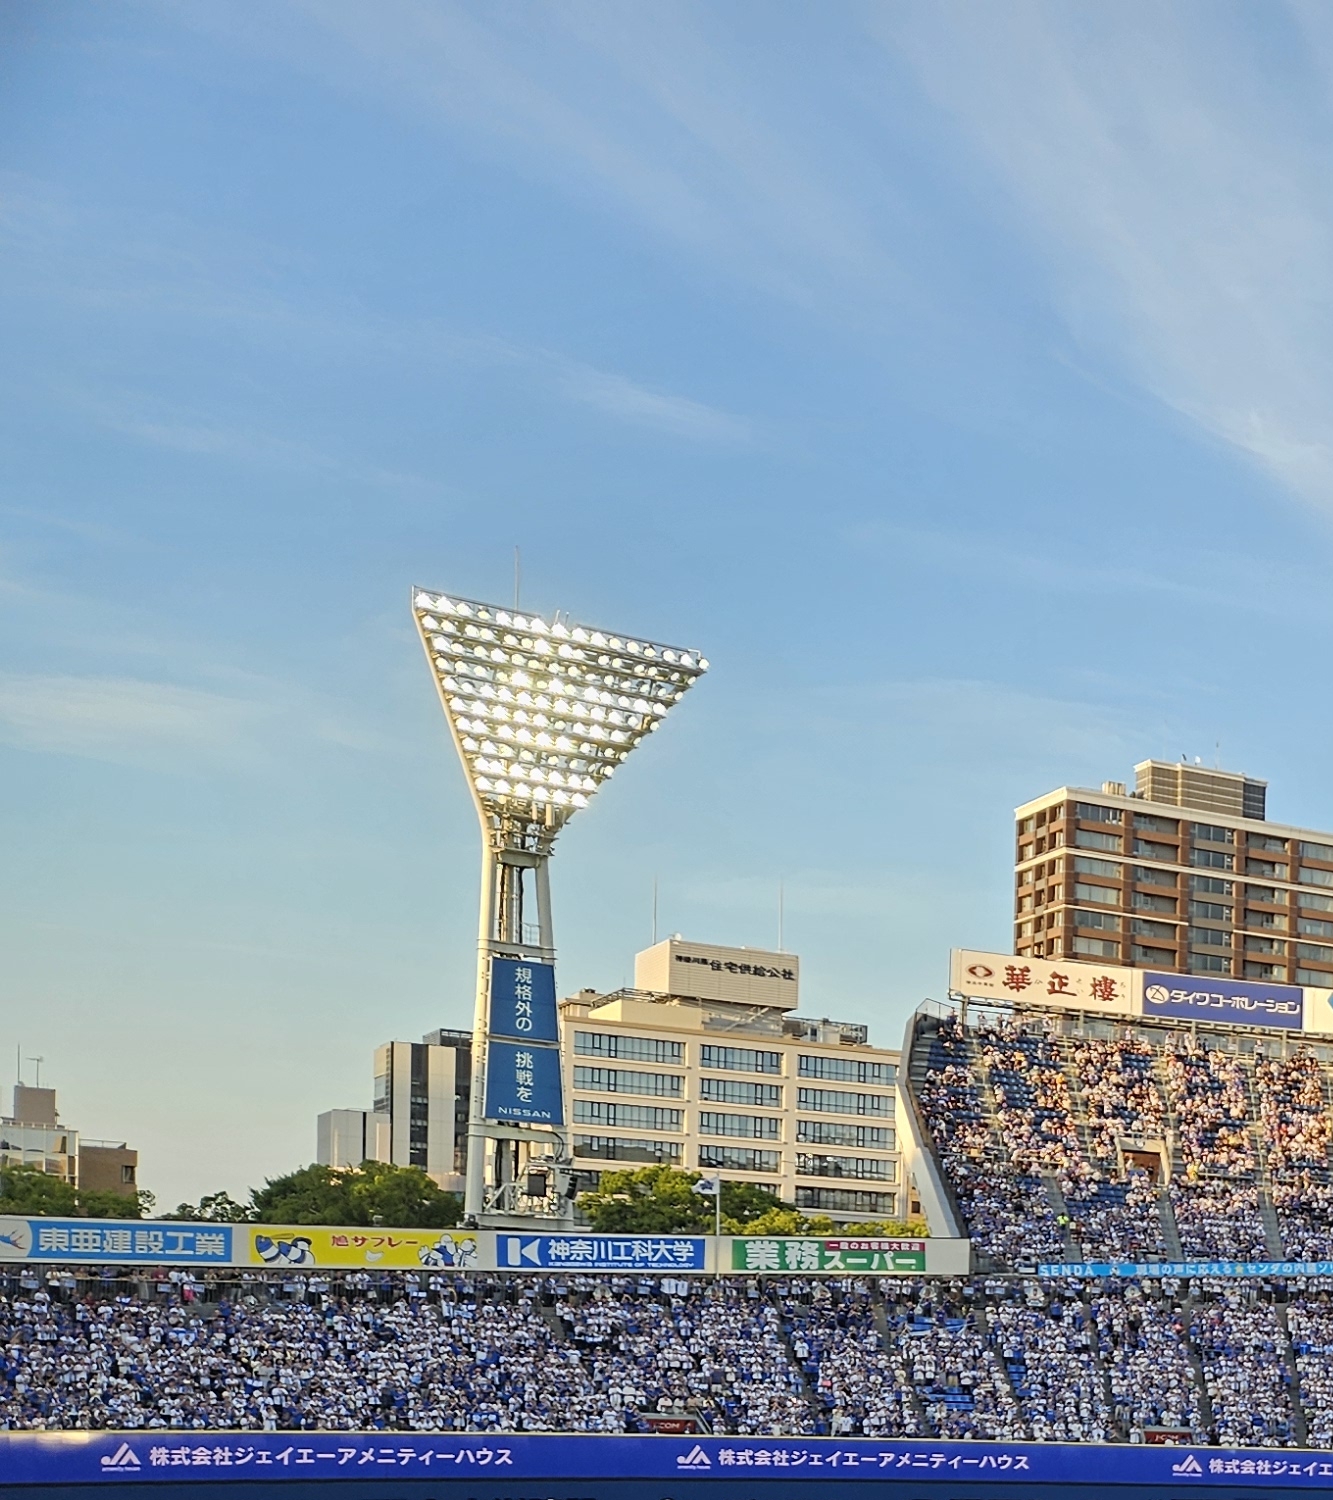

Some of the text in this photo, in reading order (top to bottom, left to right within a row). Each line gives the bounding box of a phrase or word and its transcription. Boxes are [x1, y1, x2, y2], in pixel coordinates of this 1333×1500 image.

[515, 967, 533, 1032] 規格外の
[1170, 990, 1300, 1014] ダイワコーポレーション
[516, 1053, 533, 1102] 挑戦を
[498, 1107, 550, 1119] NISSAN
[39, 1227, 226, 1256] 東亜建設工業
[548, 1238, 695, 1262] 神奈川工科大学
[745, 1240, 916, 1270] 業務スーパー
[1040, 1265, 1094, 1276] SENDA
[150, 1447, 513, 1466] 株式会社ジェイエーアメニティーハウス
[718, 1448, 1030, 1471] 株式会社ジェイエーアメニティーハウス
